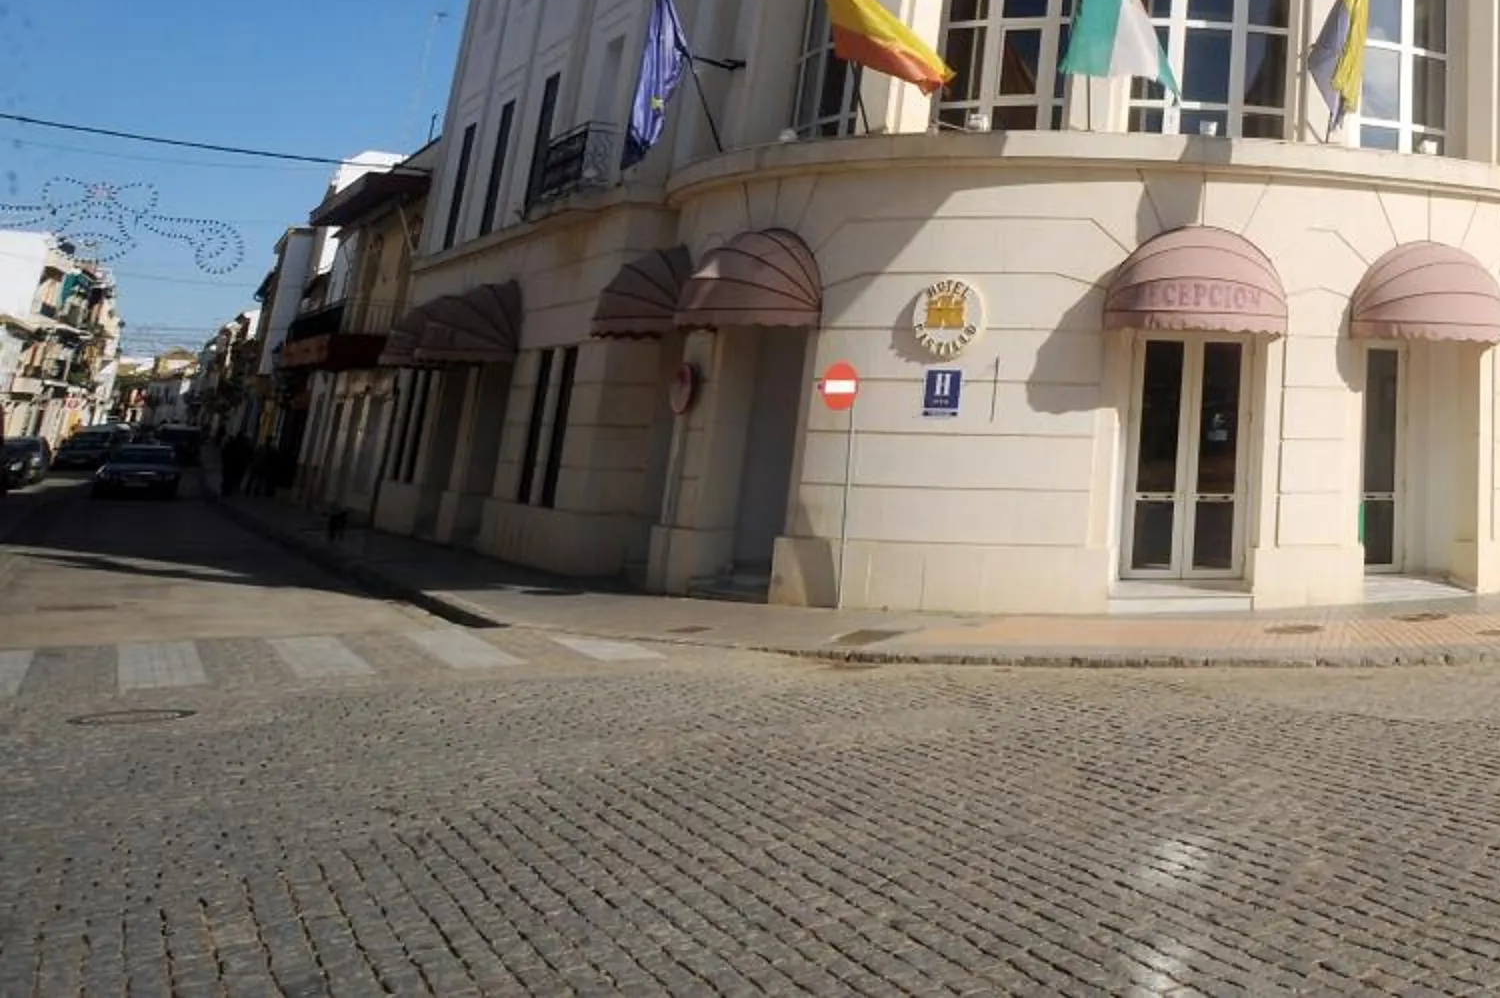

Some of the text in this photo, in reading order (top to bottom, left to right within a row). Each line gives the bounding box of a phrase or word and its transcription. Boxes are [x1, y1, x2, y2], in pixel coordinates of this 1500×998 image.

[926, 279, 970, 299] HOTEL
[1134, 281, 1262, 308] ECEPCION
[933, 373, 952, 396] H
